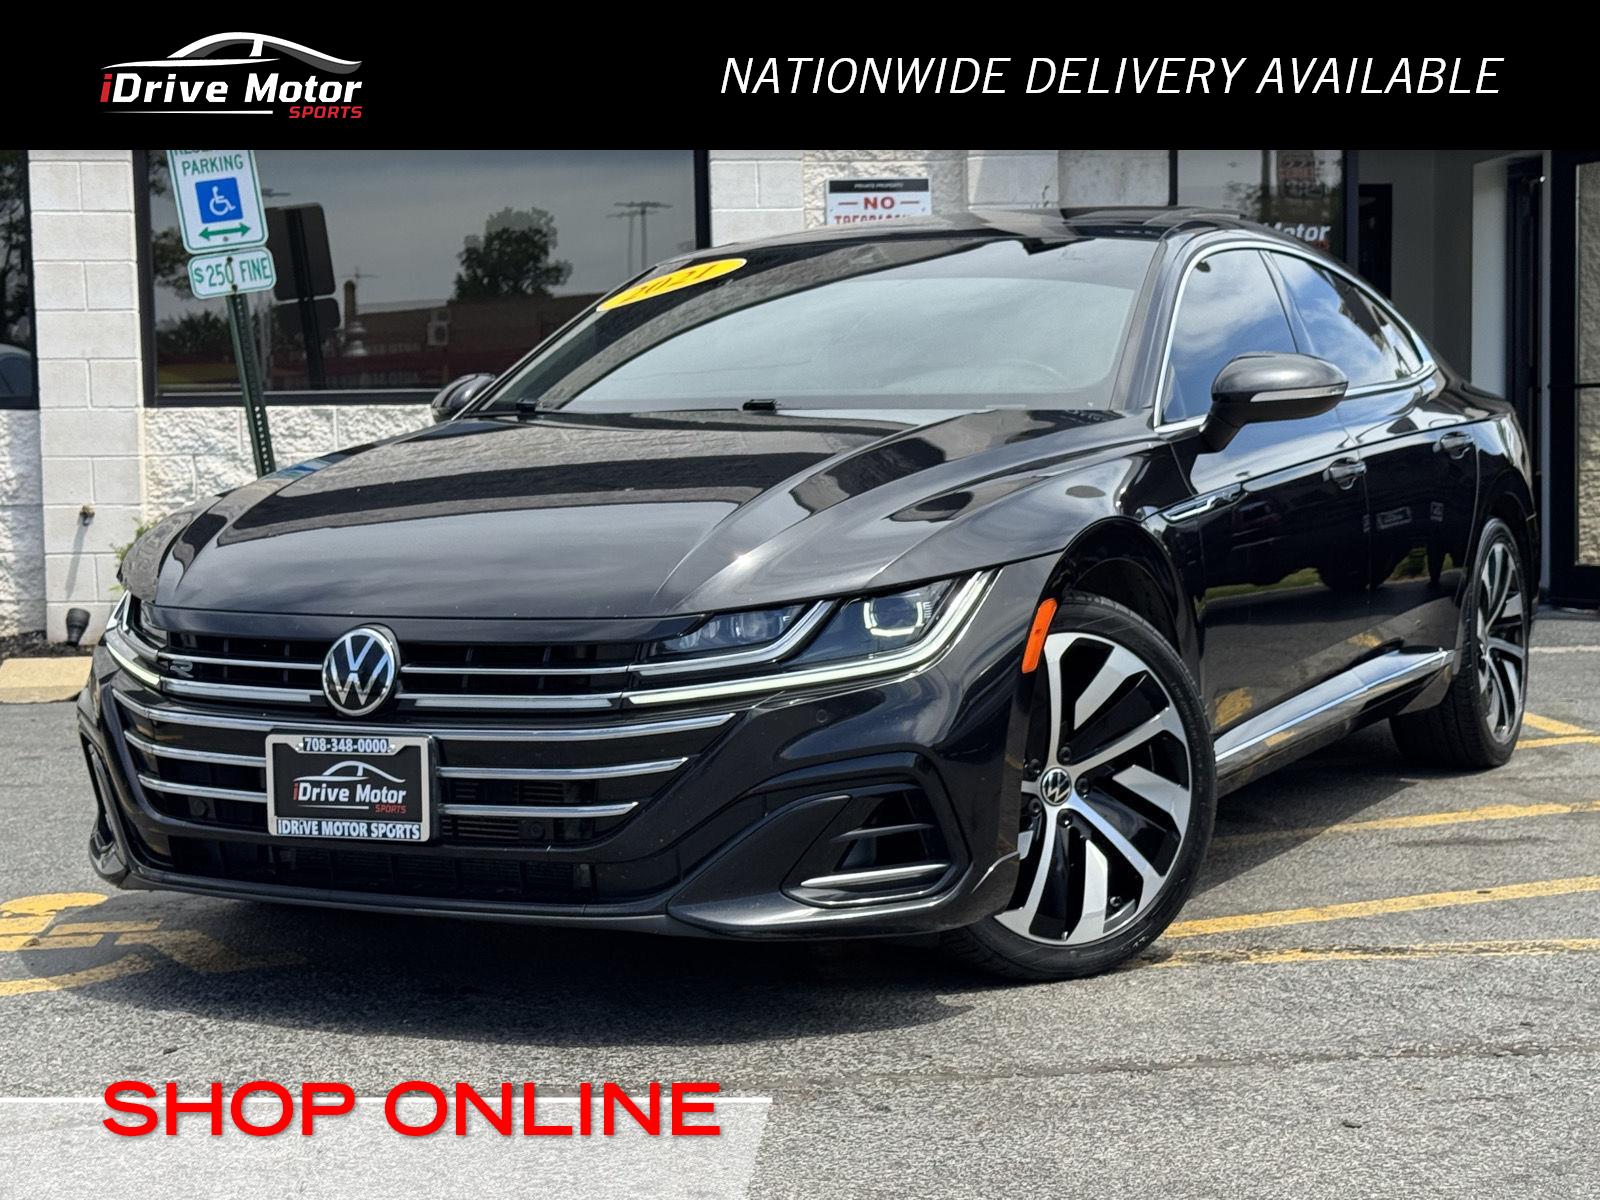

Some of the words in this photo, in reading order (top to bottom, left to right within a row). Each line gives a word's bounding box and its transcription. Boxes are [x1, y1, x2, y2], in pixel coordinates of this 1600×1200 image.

[181, 154, 244, 176] PARKING
[863, 196, 895, 210] NO
[193, 261, 235, 288] $250
[239, 257, 272, 283] FINE
[304, 737, 388, 753] 708-348-0000
[293, 782, 350, 802] iDrive
[355, 783, 407, 804] Motor
[374, 804, 408, 814] SPORTS
[321, 821, 368, 837] MOTOR
[371, 823, 420, 840] SPORTS
